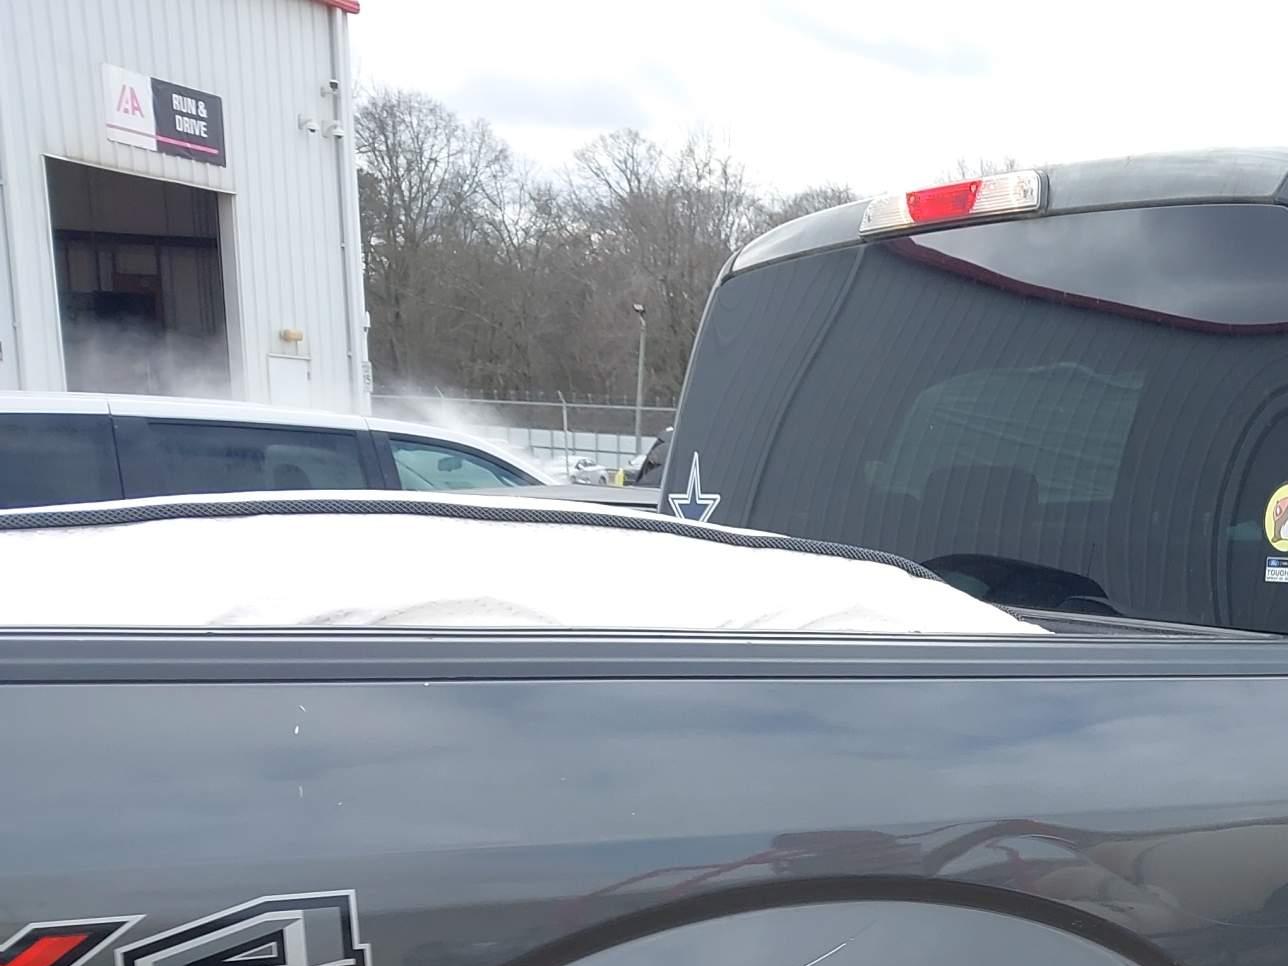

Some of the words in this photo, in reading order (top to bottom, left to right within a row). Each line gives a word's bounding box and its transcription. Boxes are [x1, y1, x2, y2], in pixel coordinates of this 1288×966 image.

[172, 93, 196, 115] RUN
[197, 100, 208, 118] &
[175, 115, 208, 138] DRIVE
